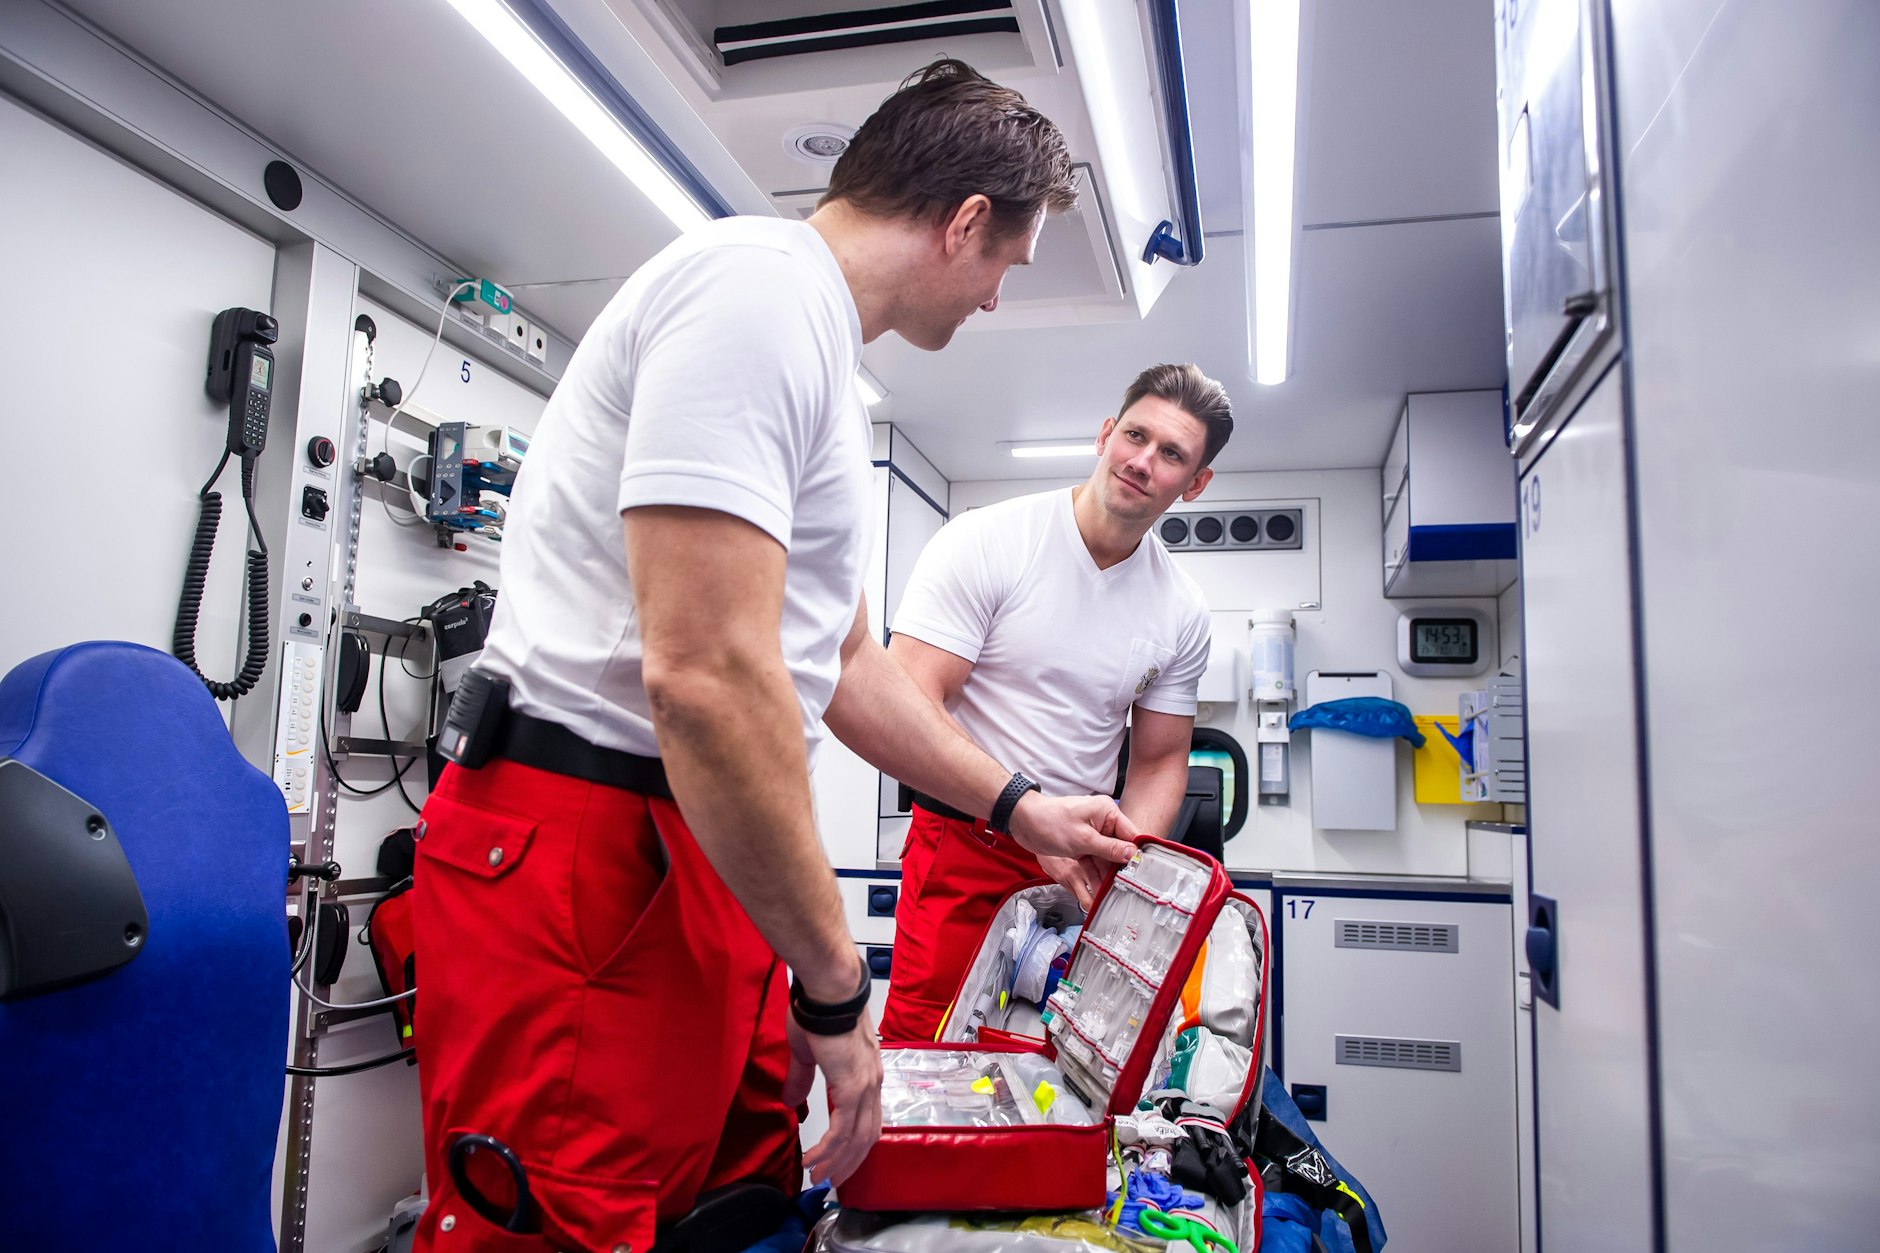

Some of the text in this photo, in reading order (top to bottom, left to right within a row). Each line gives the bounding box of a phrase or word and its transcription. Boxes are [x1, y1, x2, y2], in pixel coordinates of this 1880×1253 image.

[460, 360, 471, 384] 5
[1523, 474, 1541, 540] 19
[1286, 899, 1316, 920] 17
